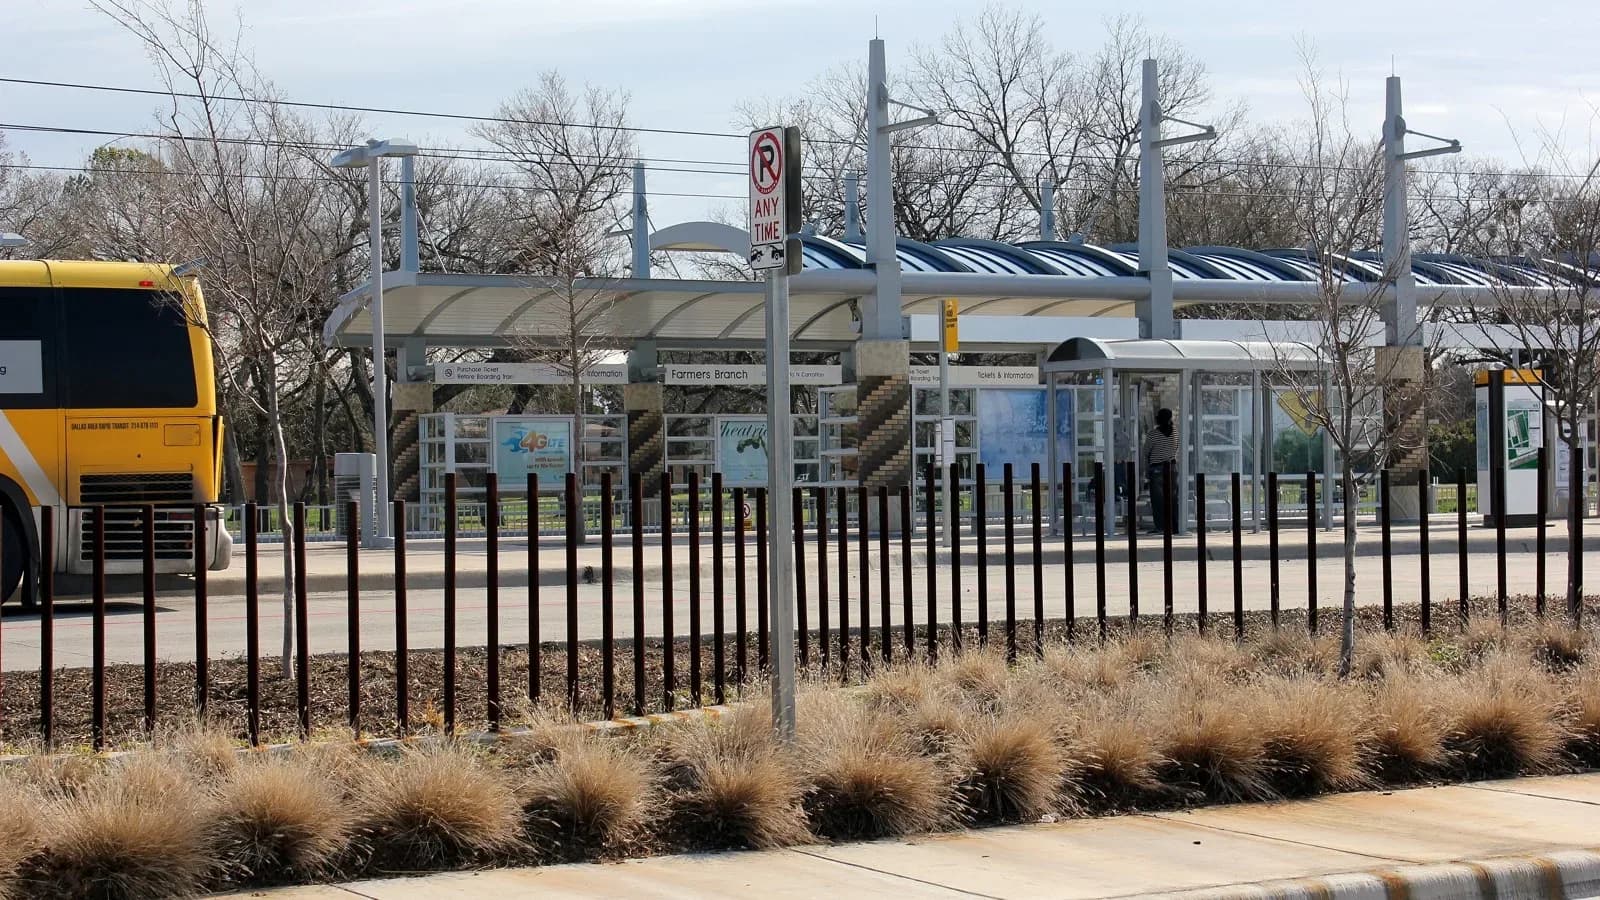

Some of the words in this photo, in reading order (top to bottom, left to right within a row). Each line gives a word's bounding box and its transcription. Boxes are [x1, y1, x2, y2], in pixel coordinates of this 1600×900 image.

[754, 196, 779, 218] ANY
[754, 220, 780, 242] TIME
[586, 369, 623, 378] Information
[671, 369, 711, 380] Farmers
[714, 369, 748, 380] Branch
[977, 371, 996, 379] Tickets
[1003, 371, 1034, 380] Information
